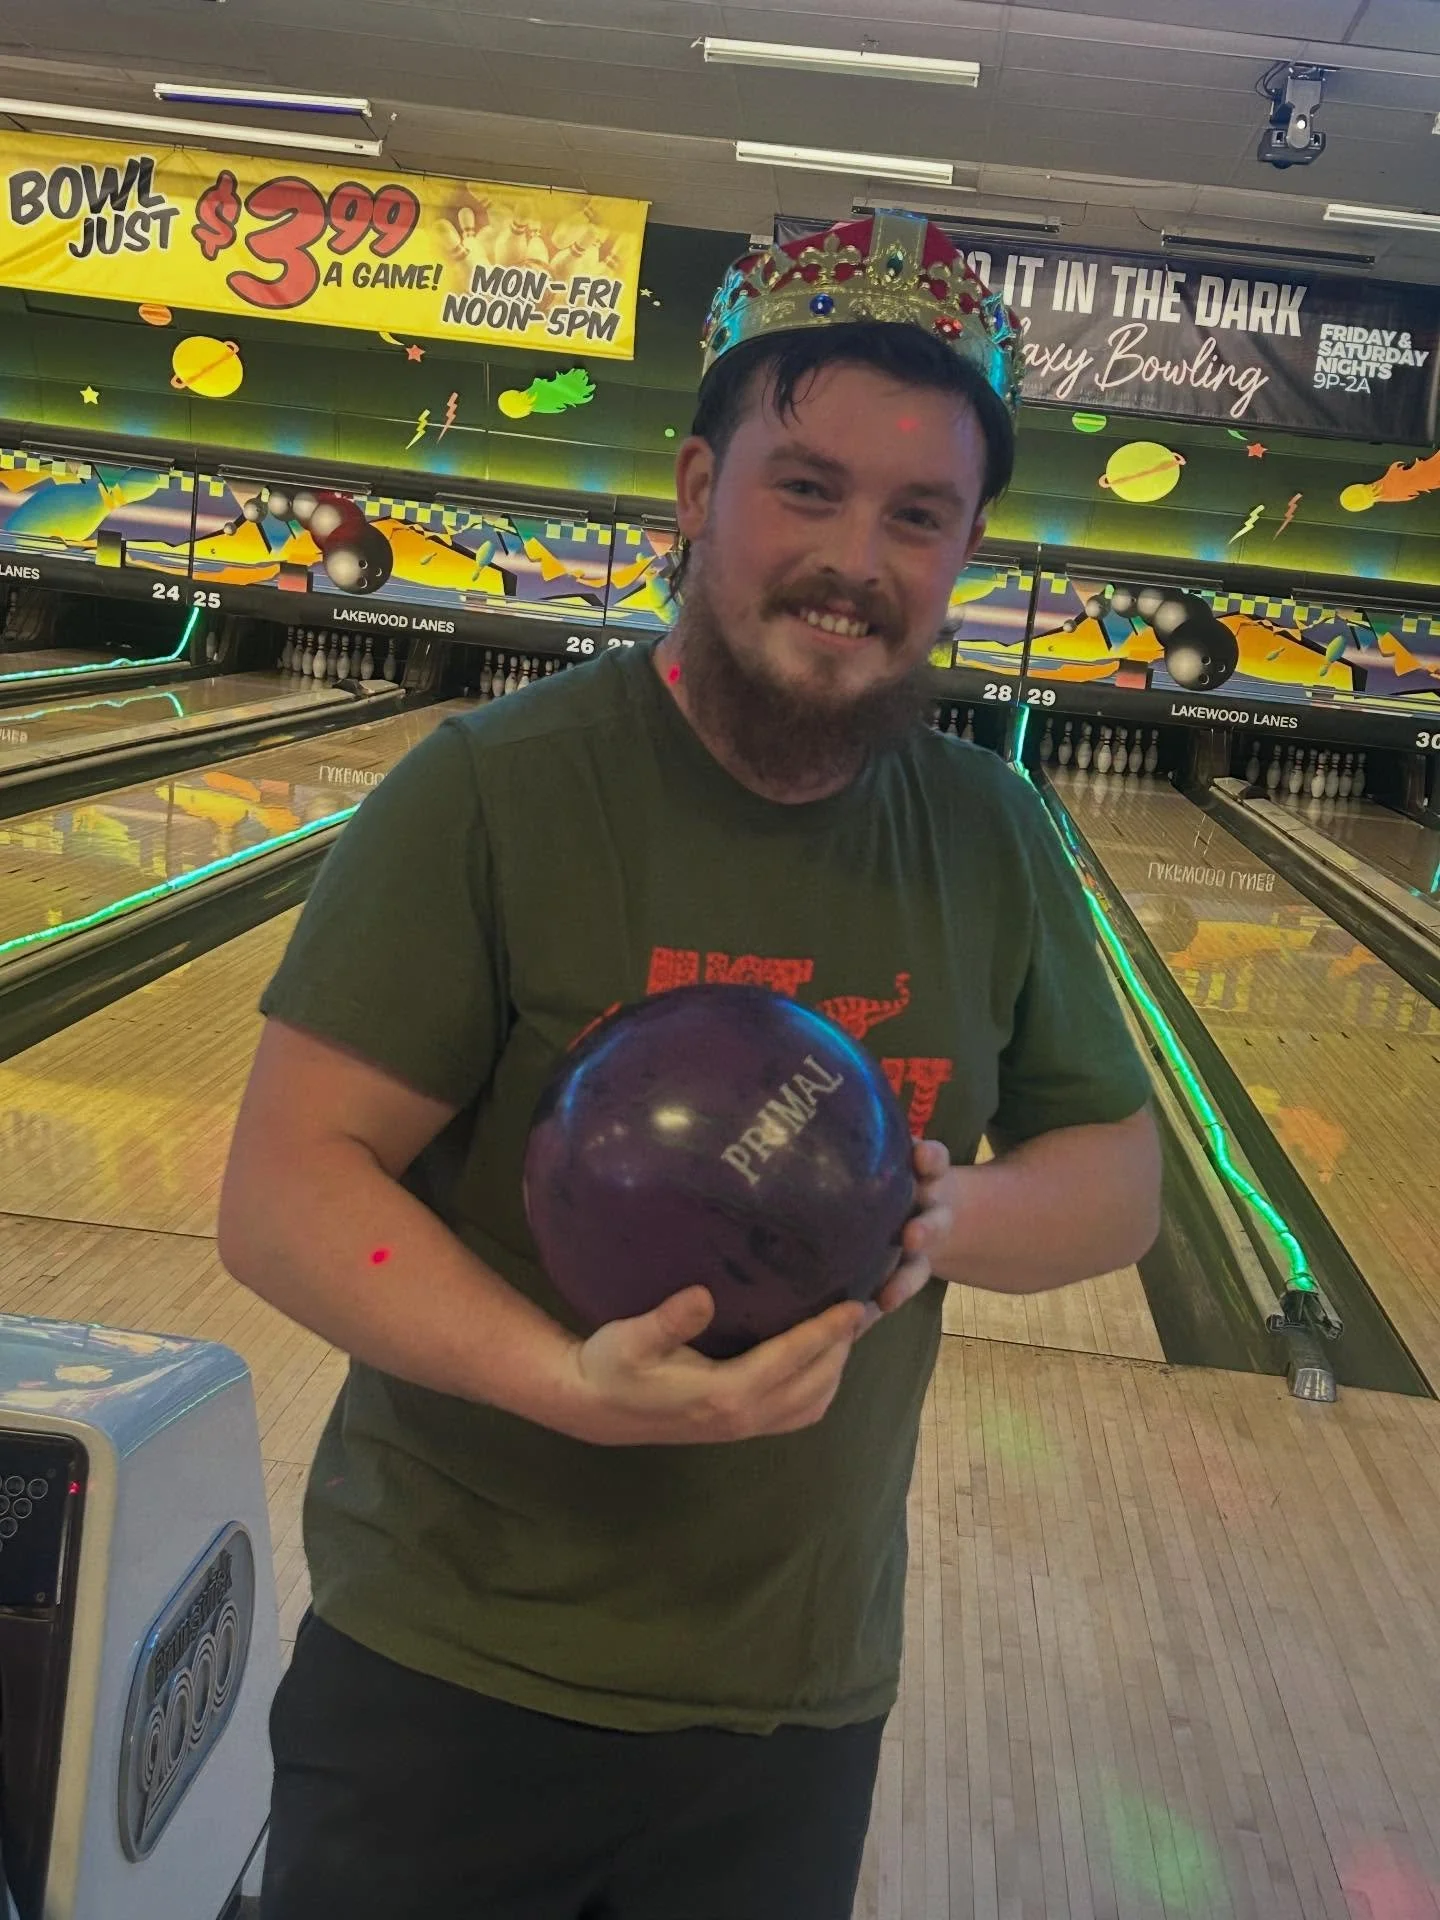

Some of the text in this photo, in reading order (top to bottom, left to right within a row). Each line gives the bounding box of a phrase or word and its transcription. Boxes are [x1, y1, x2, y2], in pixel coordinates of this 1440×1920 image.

[9, 156, 165, 225] BOWL
[68, 208, 180, 258] JUST
[323, 262, 443, 291] A GAME!
[1003, 254, 1044, 307] IT
[1052, 259, 1098, 314] IN
[1111, 265, 1187, 322] THE
[1194, 275, 1308, 338] DARK
[442, 294, 621, 341] NOON-5PM
[1320, 323, 1412, 349] FRIDAY &
[1318, 340, 1429, 367] SATURDAY
[1094, 322, 1269, 418] Bowling
[1315, 356, 1393, 380] NIGHTS
[1313, 372, 1371, 394] 9P-2A
[0, 564, 40, 580] LANES
[152, 582, 180, 602] 24
[193, 590, 221, 609] 25
[333, 608, 455, 634] LAKEWOOD LANES
[566, 636, 595, 655] 26
[983, 683, 1012, 702] 28
[1026, 688, 1056, 707] 29
[1171, 704, 1298, 729] LAKEWOOD LANES
[721, 1054, 844, 1186] PRIMAL
